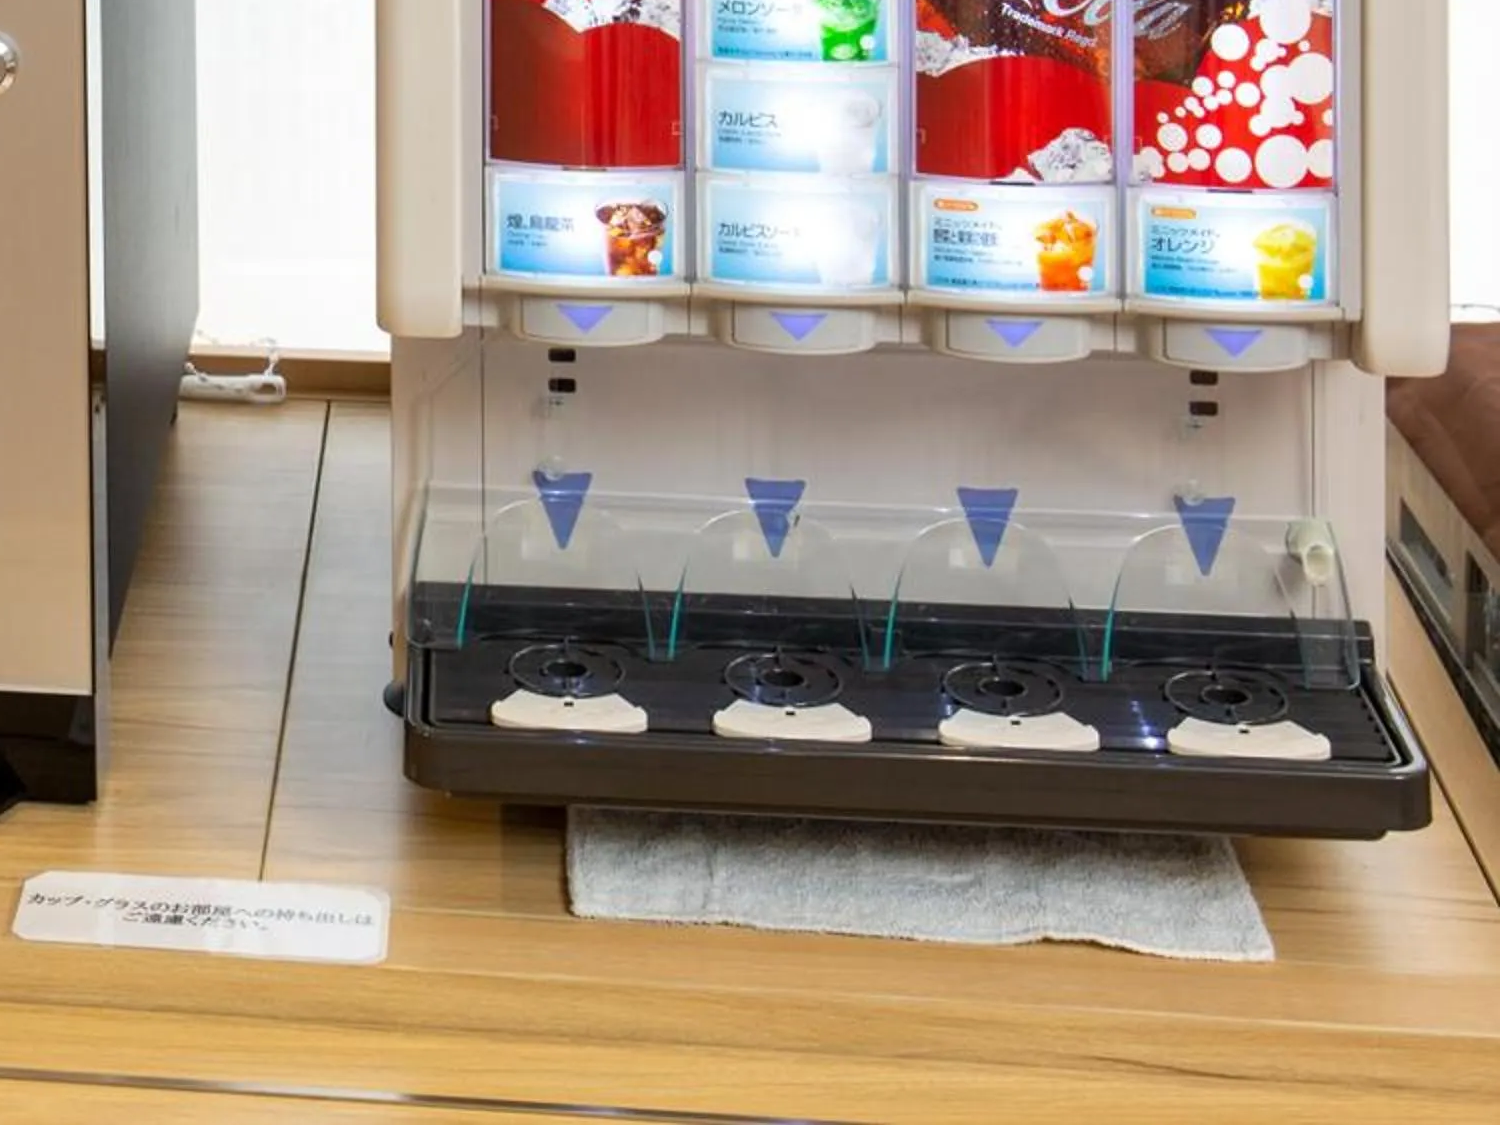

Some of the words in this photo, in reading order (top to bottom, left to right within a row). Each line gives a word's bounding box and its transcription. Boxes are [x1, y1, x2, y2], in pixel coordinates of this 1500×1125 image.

[717, 110, 778, 128] カルピス
[717, 222, 799, 239] カルピスソー
[1151, 237, 1215, 254] オレンジ
